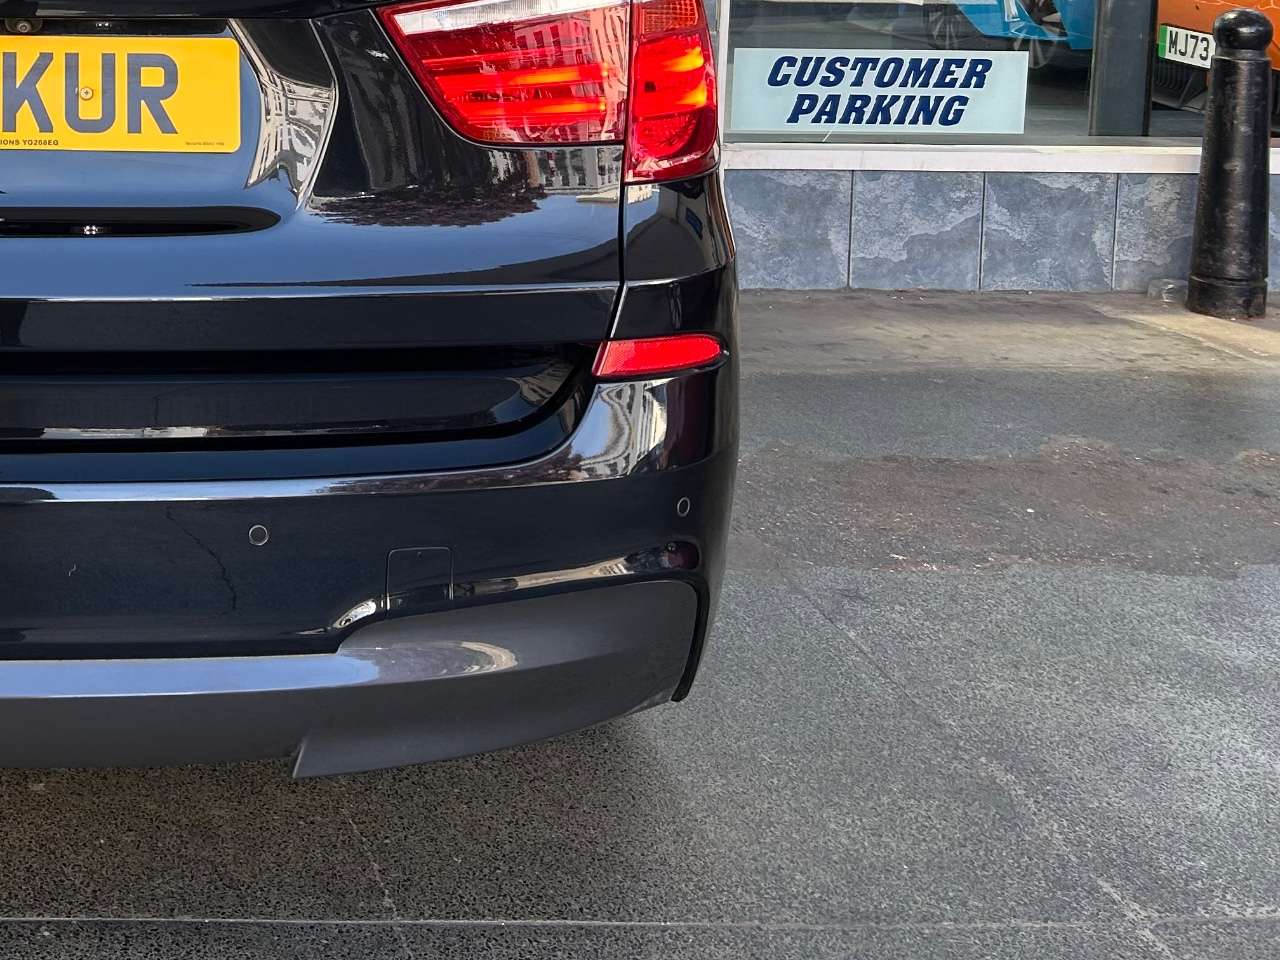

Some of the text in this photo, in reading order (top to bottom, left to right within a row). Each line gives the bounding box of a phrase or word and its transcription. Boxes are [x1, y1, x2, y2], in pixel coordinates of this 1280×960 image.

[1168, 30, 1210, 61] MJ73
[767, 55, 993, 89] CUSTOMER
[1, 51, 178, 135] KUR
[786, 94, 970, 127] PARKING
